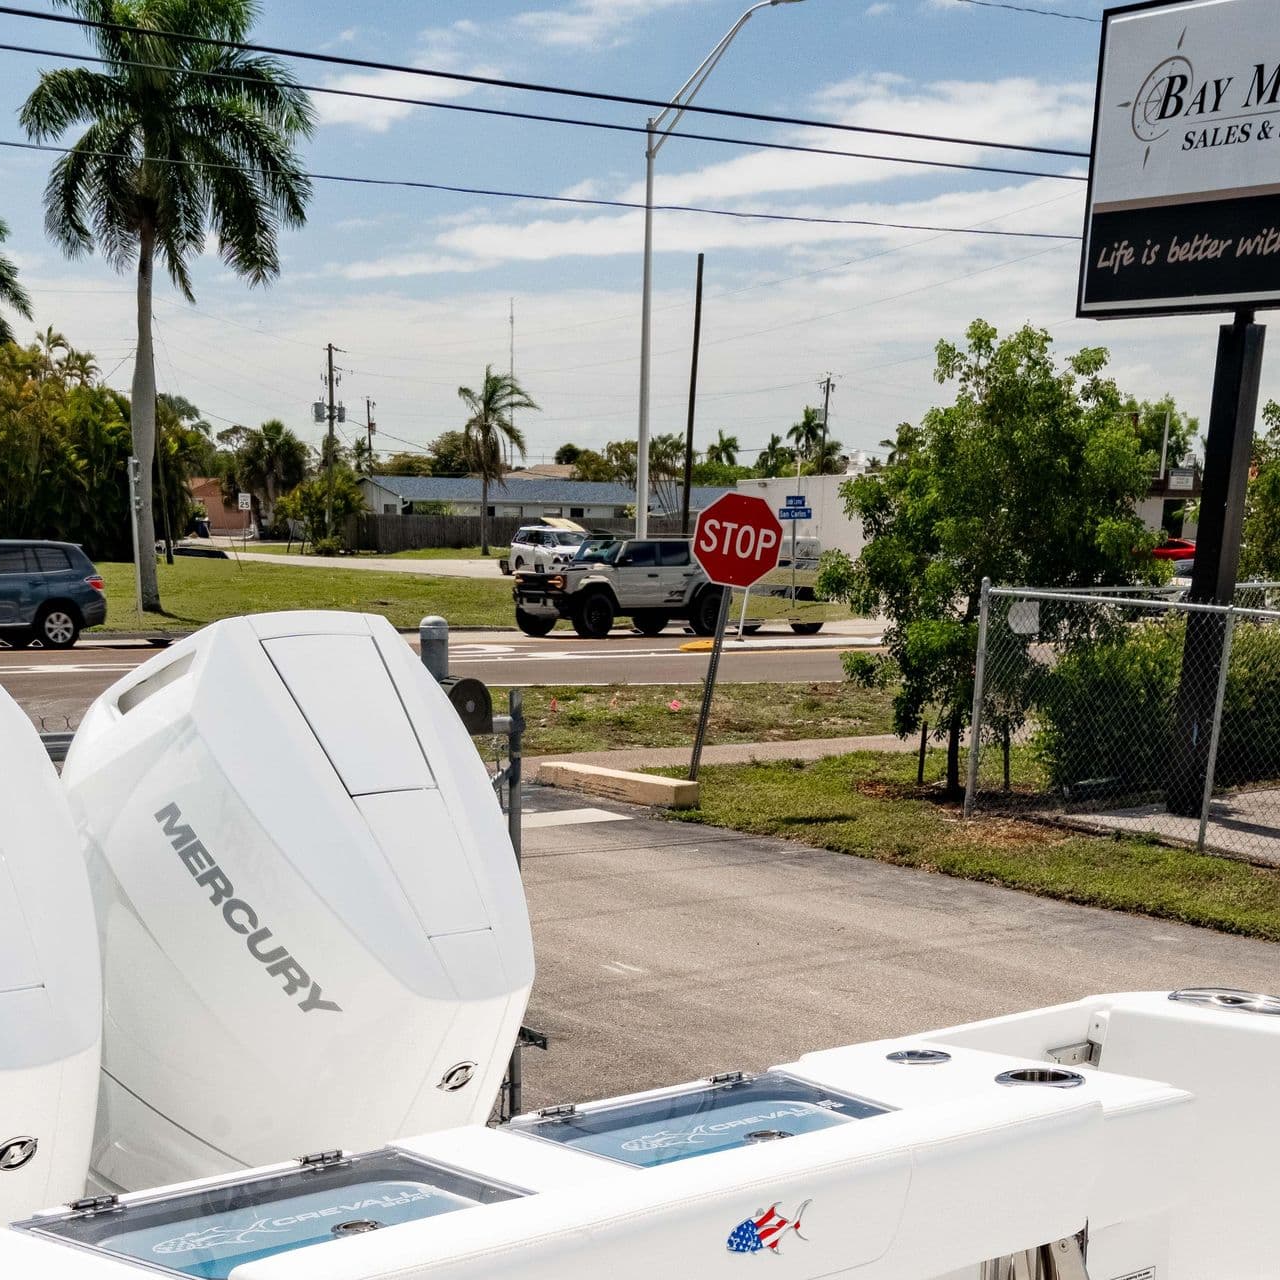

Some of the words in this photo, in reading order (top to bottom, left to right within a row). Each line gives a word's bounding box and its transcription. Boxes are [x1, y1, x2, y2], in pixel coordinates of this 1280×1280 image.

[1157, 73, 1233, 120] BAY
[1181, 122, 1251, 151] SALES
[1257, 120, 1274, 140] &
[1096, 242, 1135, 274] Life
[1141, 240, 1159, 266] is
[1167, 233, 1232, 263] better
[700, 519, 777, 560] STOP
[153, 801, 344, 1015] MERCURY
